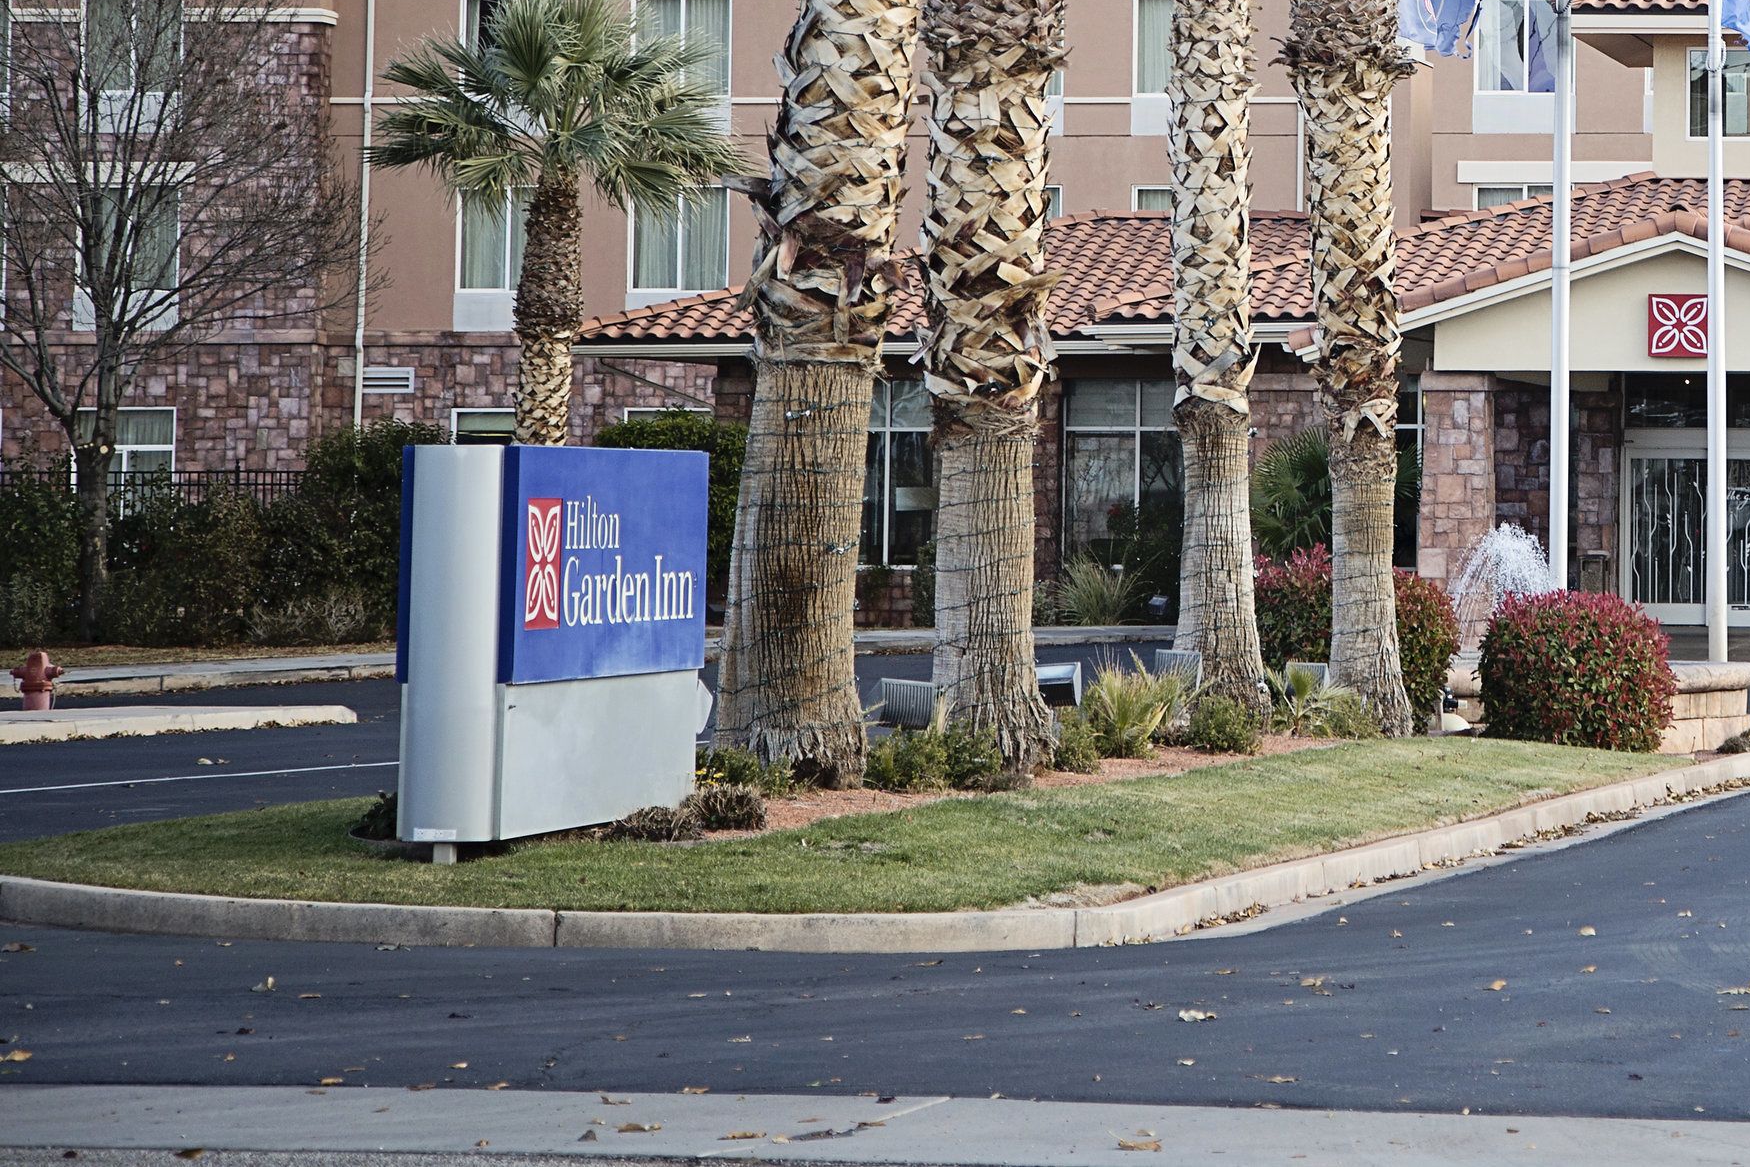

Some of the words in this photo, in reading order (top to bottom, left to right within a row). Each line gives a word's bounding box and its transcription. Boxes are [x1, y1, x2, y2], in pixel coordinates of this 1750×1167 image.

[565, 495, 620, 550] Hilton
[563, 555, 651, 627] Garden
[653, 554, 694, 622] Inn
